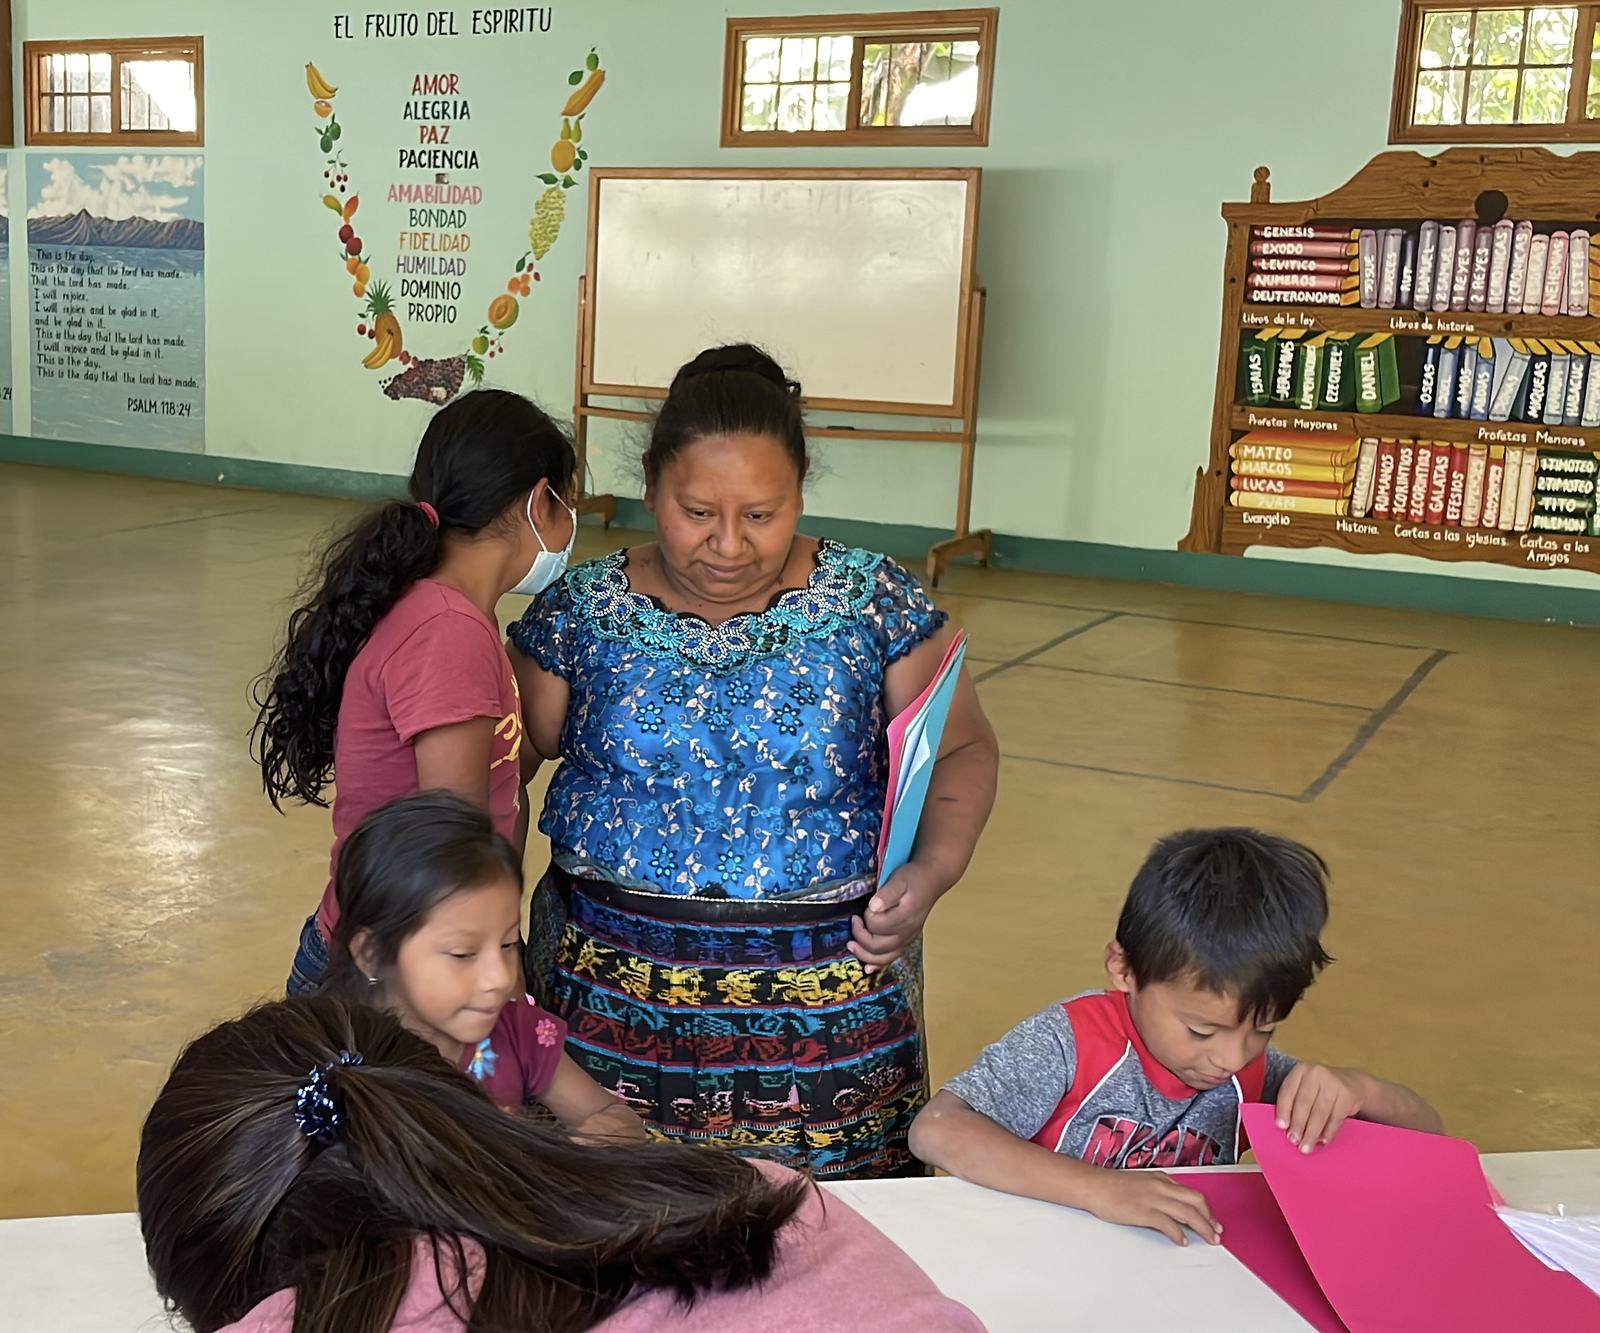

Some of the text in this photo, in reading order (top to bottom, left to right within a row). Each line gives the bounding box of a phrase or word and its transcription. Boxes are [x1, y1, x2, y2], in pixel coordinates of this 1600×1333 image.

[334, 7, 552, 38] EL FRUTO DEL ESPIRITU
[411, 73, 460, 96] AMOR
[403, 100, 471, 120] ALEGRIA
[419, 125, 450, 144] PAZ
[399, 149, 479, 169] PACIENCIA
[387, 184, 482, 205] AMABILIDAD
[409, 208, 467, 228] BONDAD
[400, 232, 471, 252] FIDELIDAD
[1263, 226, 1315, 239] GENESIS
[36, 249, 52, 260] This
[55, 252, 61, 260] is
[65, 251, 76, 260] the
[1262, 243, 1304, 255] EXODO
[31, 262, 45, 273] This
[48, 264, 54, 273] is
[57, 264, 68, 274] the
[71, 264, 84, 276] day
[87, 265, 103, 275] that
[107, 266, 118, 276] the
[141, 267, 154, 278] has
[396, 256, 466, 276] HUMILDAD
[1261, 259, 1317, 271] LEVITICO
[1364, 255, 1375, 294] JOSUE
[1453, 248, 1470, 291] REYES
[1472, 247, 1489, 290] REYES
[1571, 251, 1585, 295] ESTER
[53, 276, 65, 287] the
[88, 277, 102, 289] has
[1255, 274, 1317, 287] NUMEROS
[1400, 265, 1413, 292] RUT
[34, 288, 39, 299] I
[43, 289, 57, 300] will
[401, 278, 461, 300] DOMINIO
[1252, 290, 1341, 305] DEUTERONOMIO
[35, 301, 40, 312] I
[43, 302, 58, 313] will
[90, 304, 104, 315] and
[108, 305, 116, 316] be
[121, 306, 137, 319] glad
[140, 308, 148, 318] in
[408, 302, 457, 323] PROPIO
[1242, 312, 1269, 325] Libros
[1286, 312, 1296, 325] la
[35, 315, 49, 326] and
[54, 315, 62, 327] be
[67, 316, 83, 329] glad
[87, 318, 94, 328] in
[1390, 316, 1420, 330] Libros
[1437, 319, 1475, 332] historia
[36, 327, 53, 339] This
[56, 331, 62, 340] is
[64, 329, 76, 340] the
[78, 330, 92, 343] day
[95, 331, 111, 342] that
[114, 332, 126, 344] the
[146, 334, 160, 346] has
[36, 353, 55, 365] This
[58, 357, 64, 365] is
[67, 355, 81, 367] the
[43, 342, 60, 353] will
[64, 344, 88, 355] rejoice
[90, 344, 106, 356] and
[110, 345, 119, 356] be
[122, 346, 140, 360] glad
[143, 348, 151, 359] in
[36, 365, 54, 377] This
[58, 369, 64, 378] is
[67, 368, 80, 379] the
[84, 369, 99, 383] day
[102, 371, 118, 382] that
[123, 371, 135, 384] the
[158, 375, 172, 386] has
[1249, 353, 1265, 394] ISAIAS
[1276, 340, 1294, 398] JEREMIAS
[1325, 350, 1343, 403] EZEQUIEL
[1360, 351, 1377, 400] DANIEL
[1420, 363, 1435, 404] OSEAS
[1456, 367, 1472, 403] AMOS
[1566, 361, 1584, 417] HABACUC
[127, 397, 192, 417] PSALM 118:24
[1478, 427, 1586, 447] Profetas Menores
[1243, 445, 1292, 460] MATEO
[1241, 462, 1293, 476] MARCOS
[1243, 477, 1284, 493] LUCAS
[1374, 454, 1394, 512] ROMANOS
[1429, 455, 1449, 513] GALATAS
[1257, 497, 1296, 509] JUAN
[1446, 471, 1465, 520] EFESIOS
[1242, 512, 1290, 529] Evangelio
[1394, 524, 1430, 539] Cartas
[1433, 531, 1441, 540] a
[1444, 529, 1460, 542] las
[1520, 534, 1590, 553] Cartas a los
[1527, 549, 1570, 567] Amigos
